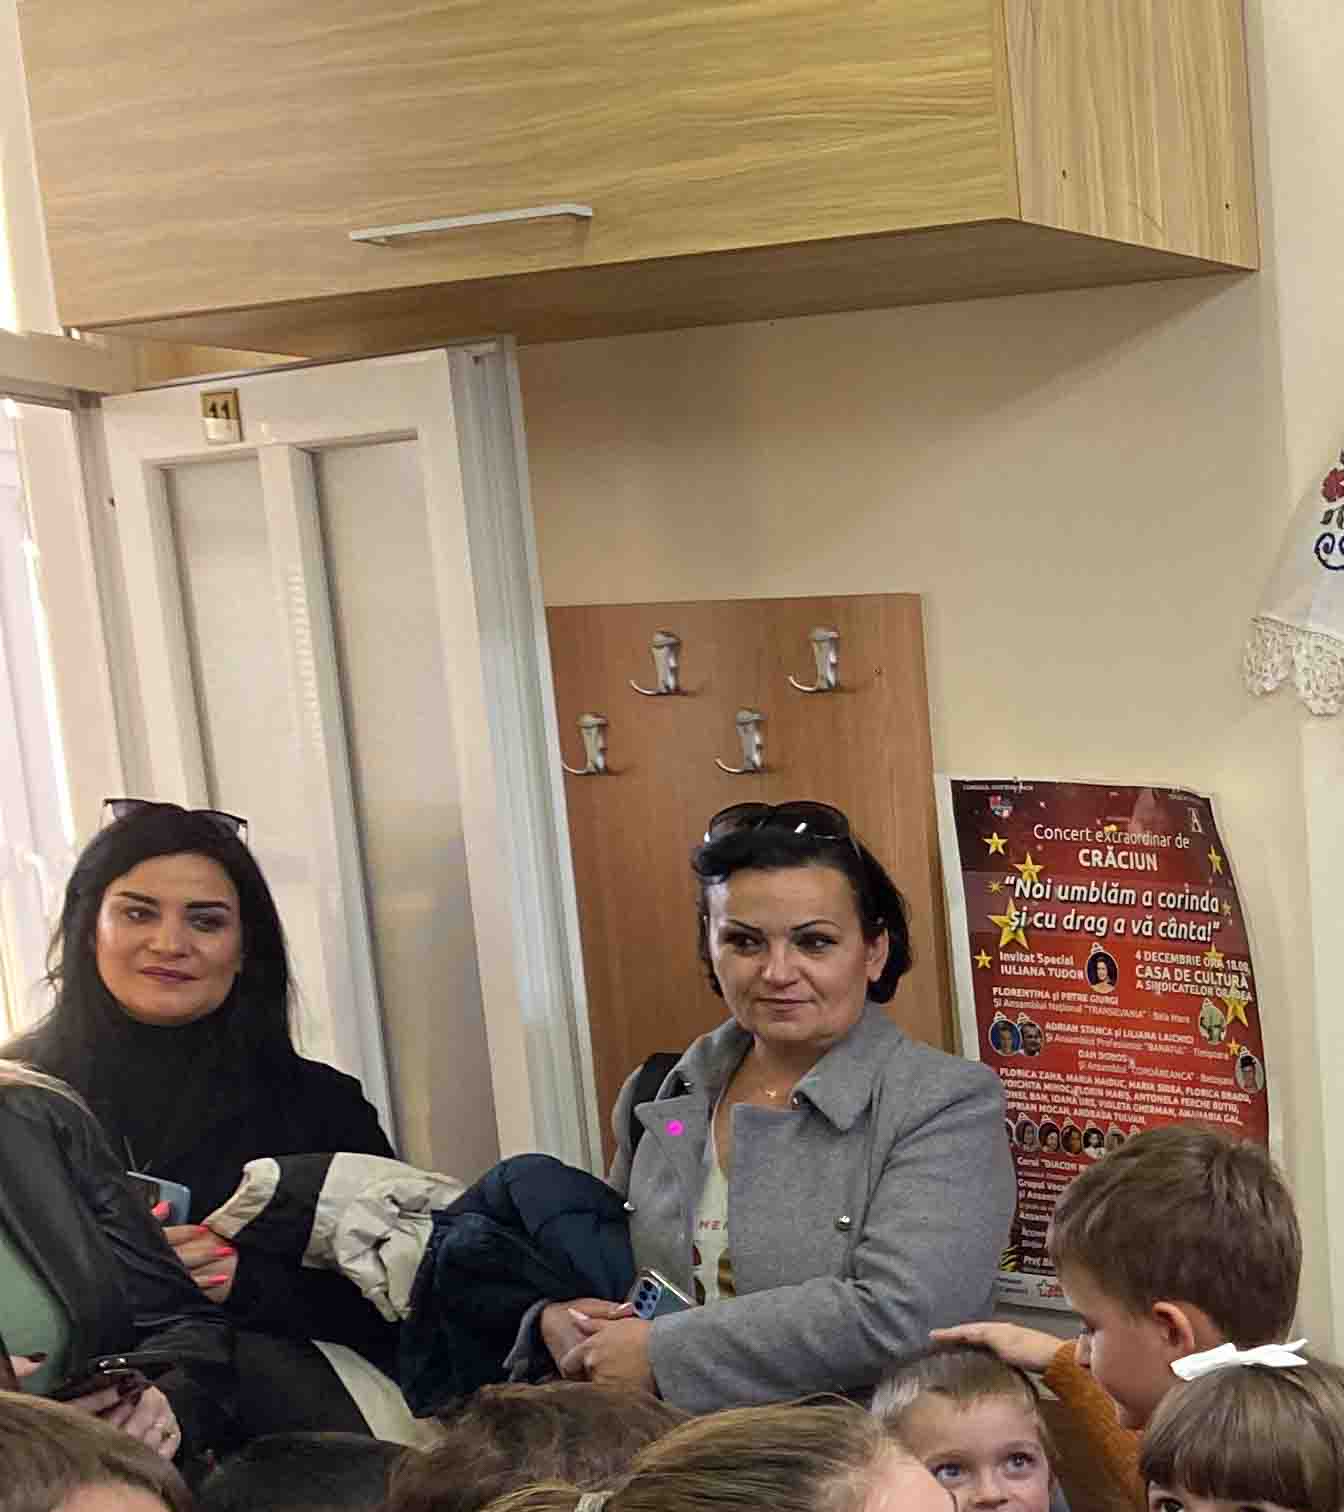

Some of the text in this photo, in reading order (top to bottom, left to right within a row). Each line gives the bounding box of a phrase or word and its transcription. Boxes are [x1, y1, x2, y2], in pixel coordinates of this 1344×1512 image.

[1033, 824, 1191, 849] Concert extraordinar de
[1078, 845, 1159, 871] CRĂCIUN
[1056, 881, 1136, 905] umblăm
[1142, 890, 1153, 907] a
[1158, 887, 1220, 913] corinda
[1033, 911, 1056, 929] cu
[1062, 909, 1107, 936] drag
[1113, 919, 1125, 934] a
[1131, 913, 1153, 936] vă
[1000, 952, 1074, 968] Invitat Special
[1135, 950, 1142, 961] 4
[1143, 952, 1201, 967] DECEMBRIE
[1000, 964, 1084, 980] IULIANA TUDOR
[1135, 965, 1172, 980] CASA
[1175, 967, 1192, 982] DE
[1135, 980, 1143, 990] A
